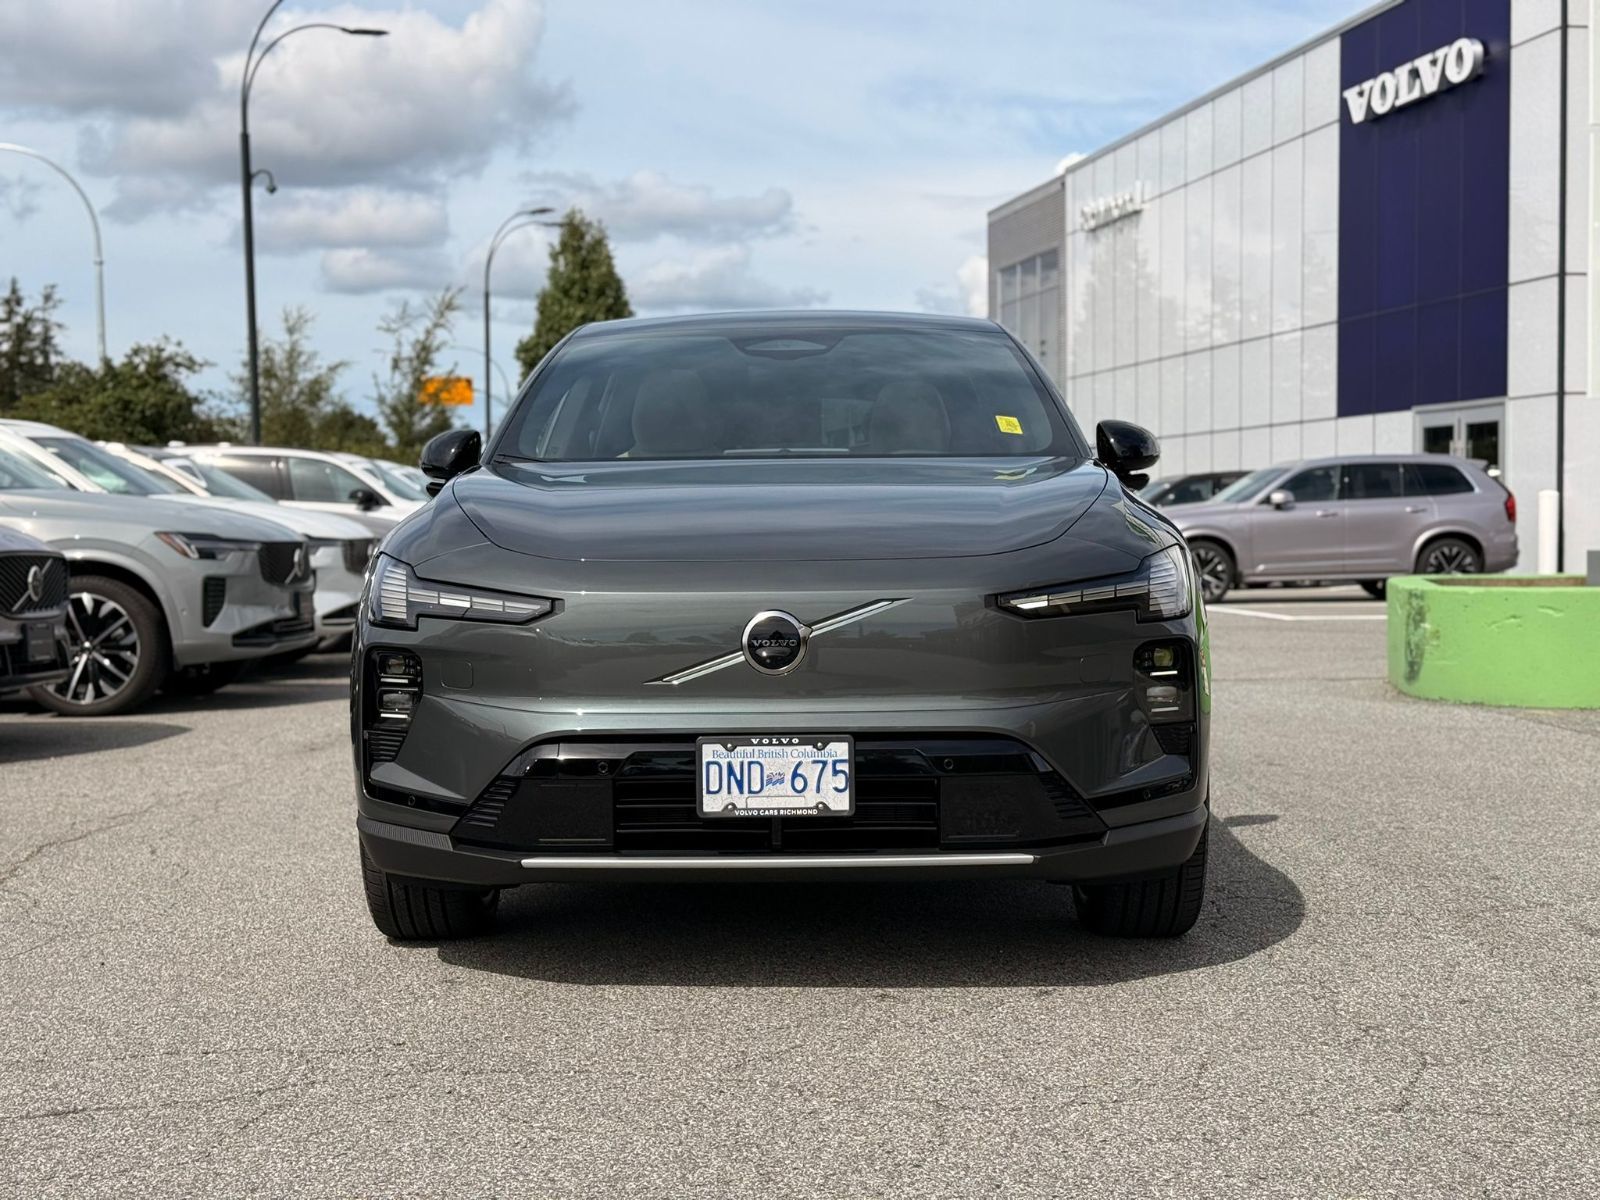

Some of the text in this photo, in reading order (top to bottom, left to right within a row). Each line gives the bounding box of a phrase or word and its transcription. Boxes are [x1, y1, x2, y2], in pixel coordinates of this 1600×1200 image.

[1342, 37, 1480, 124] VOLVO
[751, 639, 798, 647] VOLVO
[712, 747, 838, 759] Beautiful British Columbia
[705, 759, 849, 795] DND 675
[779, 808, 818, 816] RICHMOND
